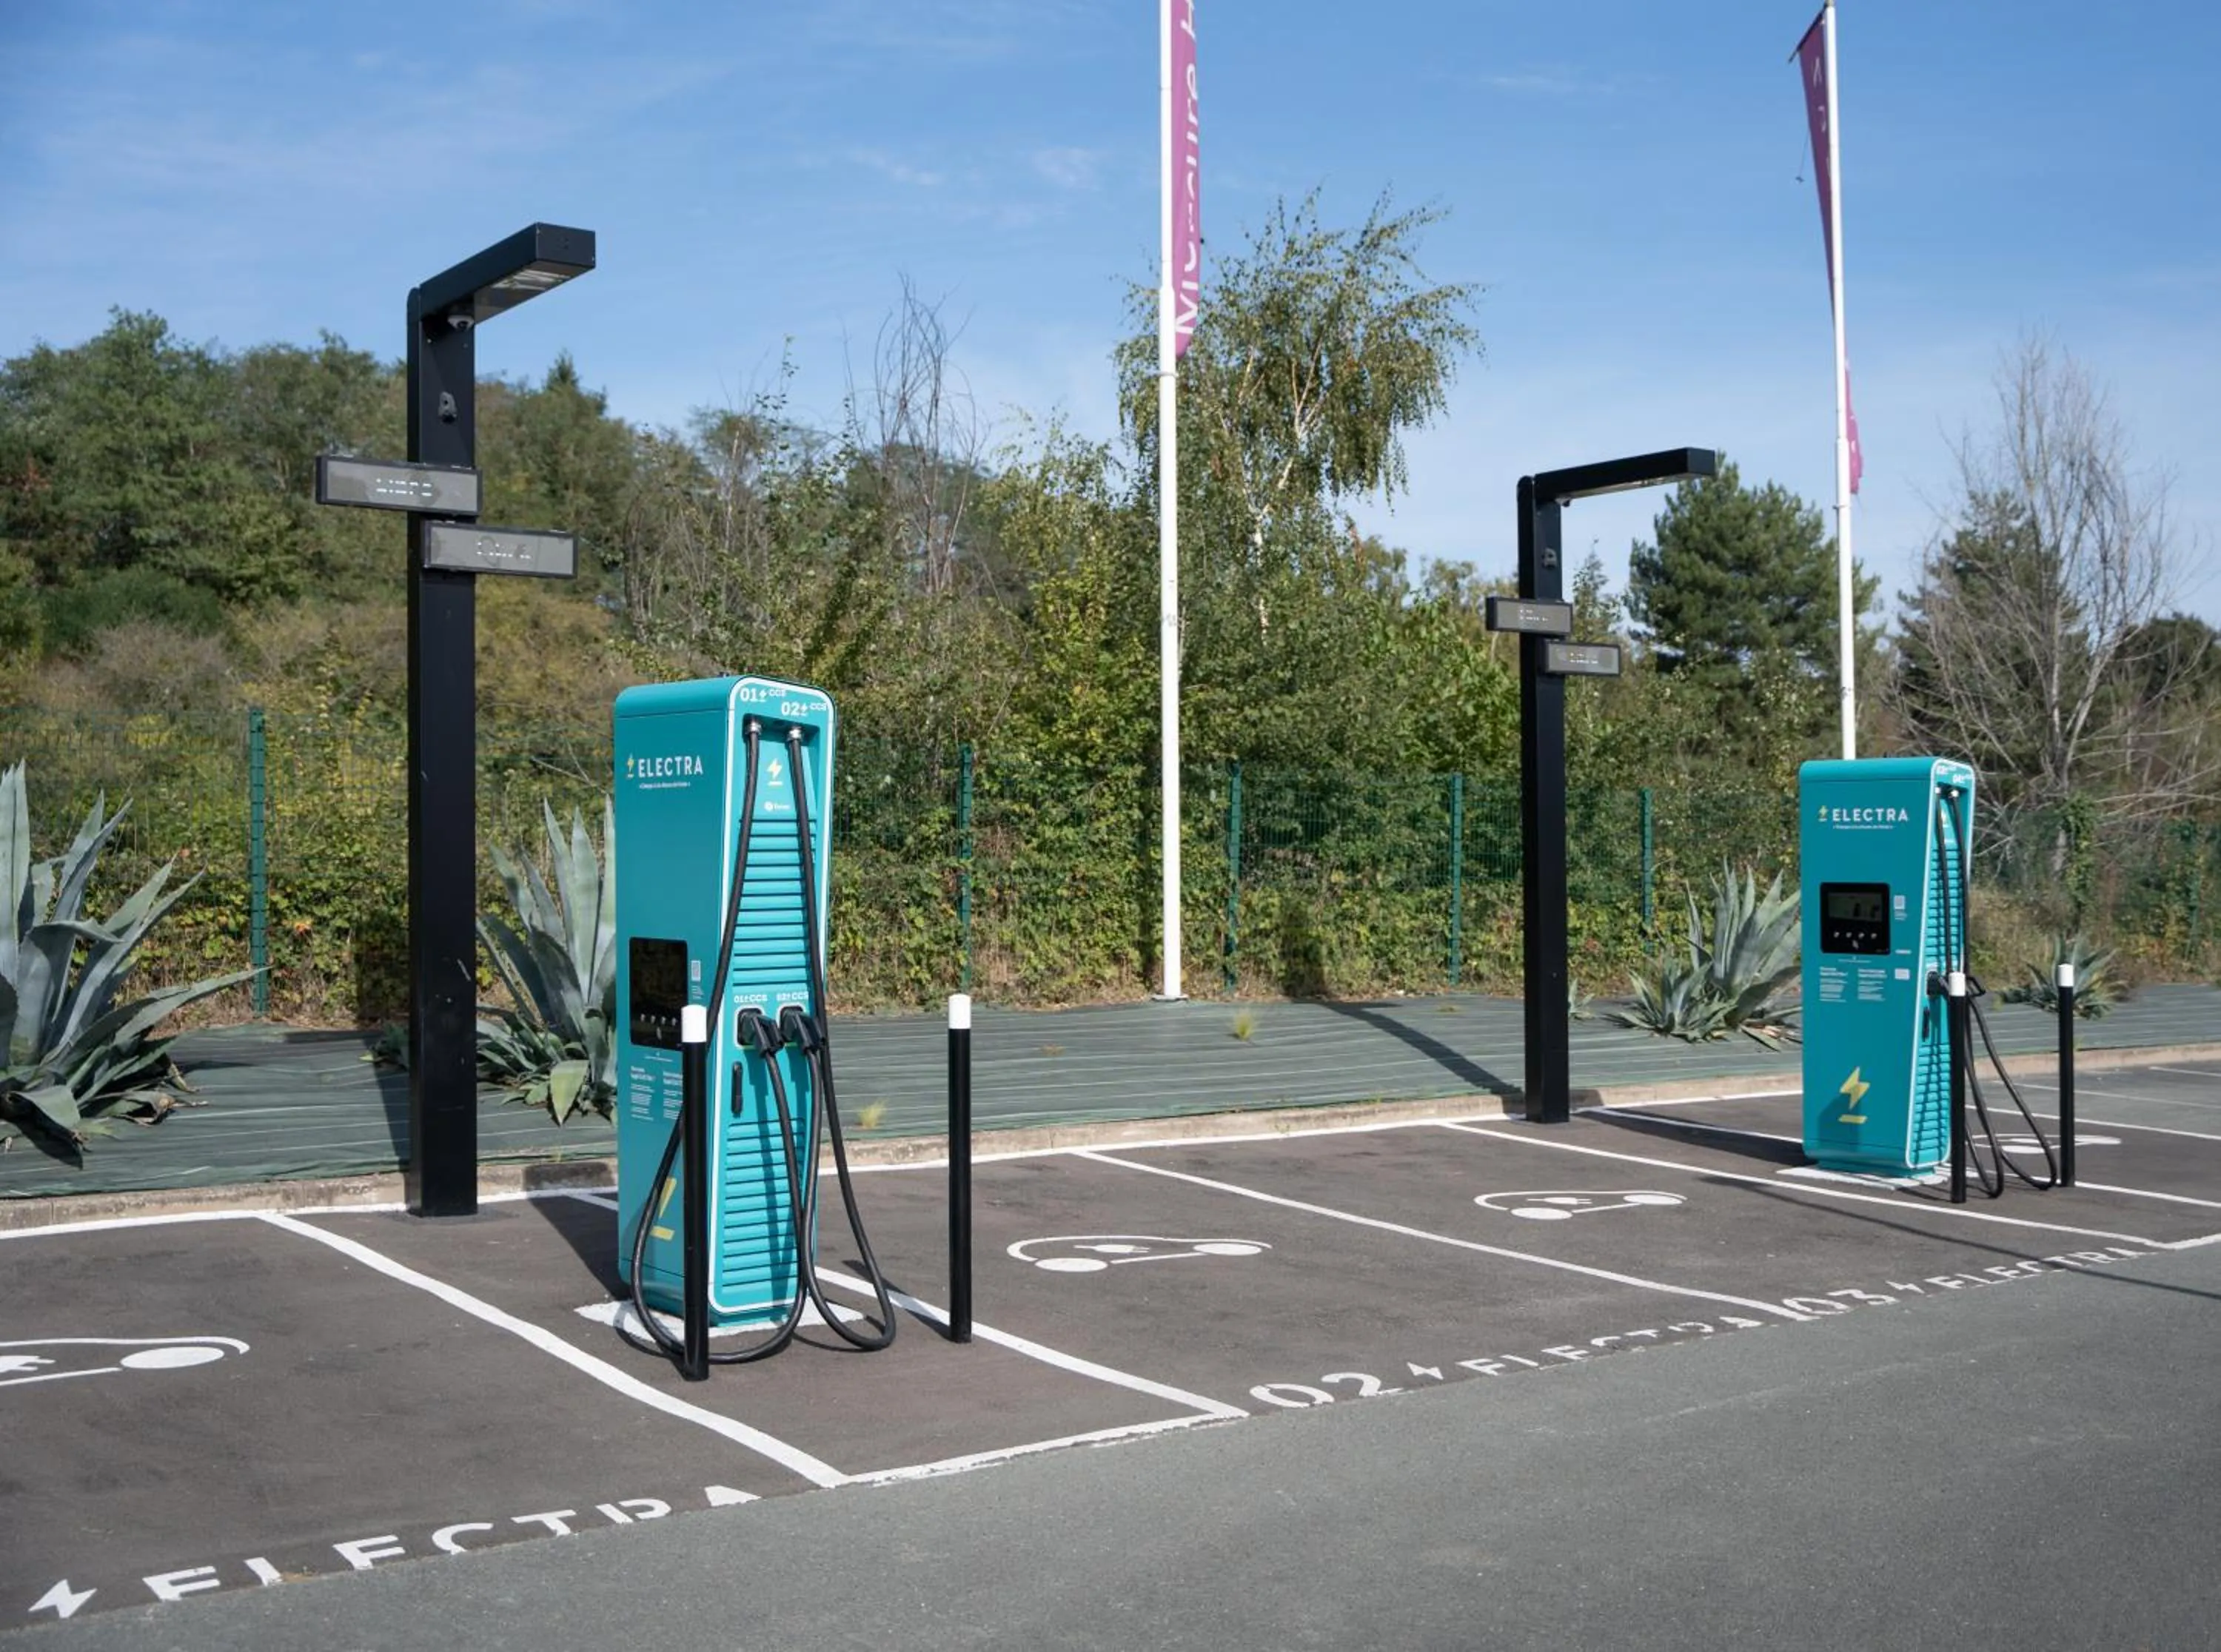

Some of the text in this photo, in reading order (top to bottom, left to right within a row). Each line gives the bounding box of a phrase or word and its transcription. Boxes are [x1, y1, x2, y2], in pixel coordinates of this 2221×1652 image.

[740, 688, 758, 702] 01
[781, 702, 799, 716] 02
[638, 755, 703, 778] ELECTRA
[1832, 807, 1908, 822] ELECTRA
[1249, 1371, 1404, 1408] 02
